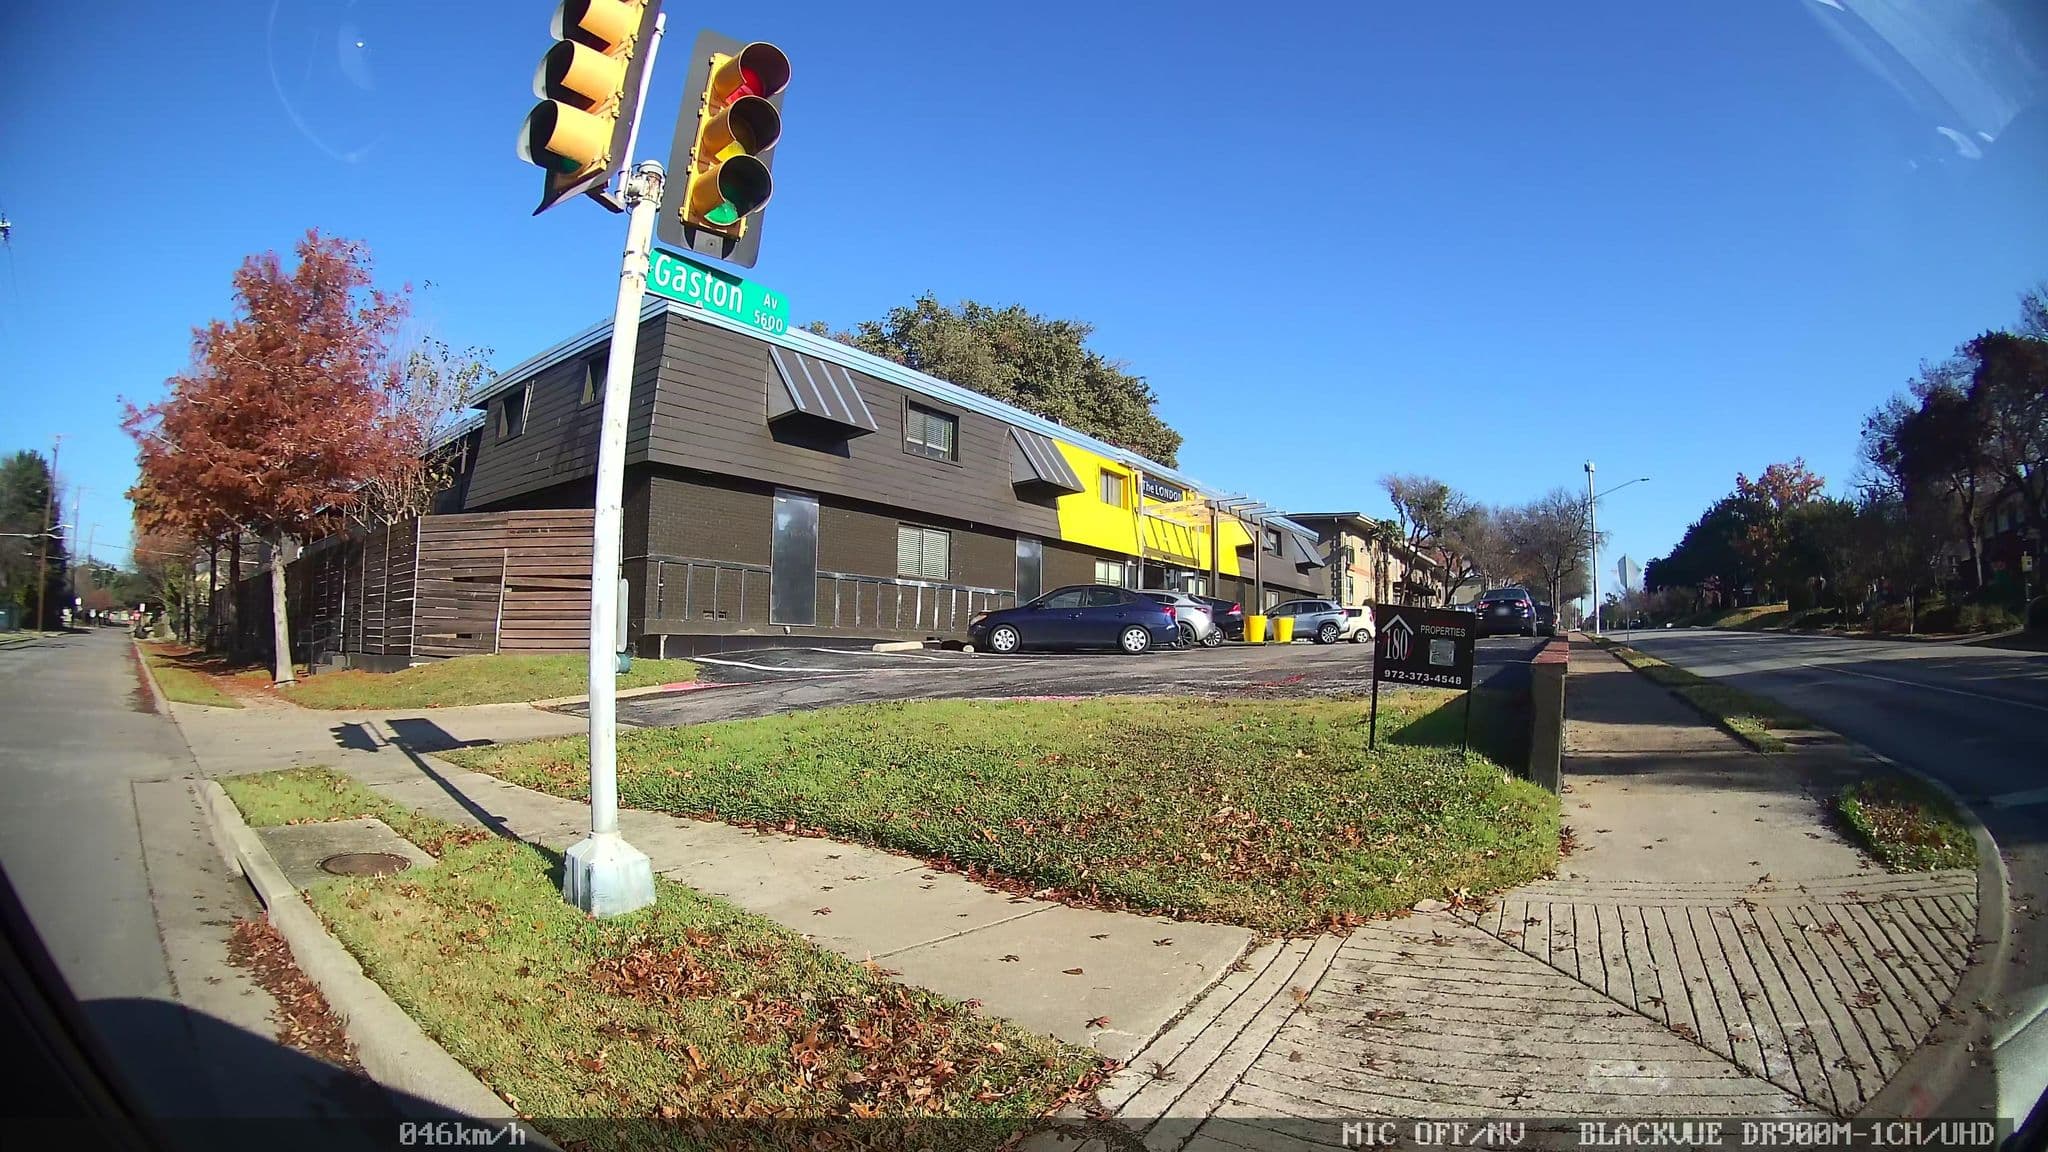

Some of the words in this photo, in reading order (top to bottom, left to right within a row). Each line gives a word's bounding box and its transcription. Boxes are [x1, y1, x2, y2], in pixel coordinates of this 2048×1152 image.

[654, 254, 743, 314] Gaston
[763, 293, 778, 311] Av
[754, 310, 783, 332] 5600
[1143, 480, 1155, 494] The
[1420, 624, 1466, 638] PROPERTIES
[1384, 628, 1409, 661] 180
[1384, 669, 1462, 685] 972-373-4548
